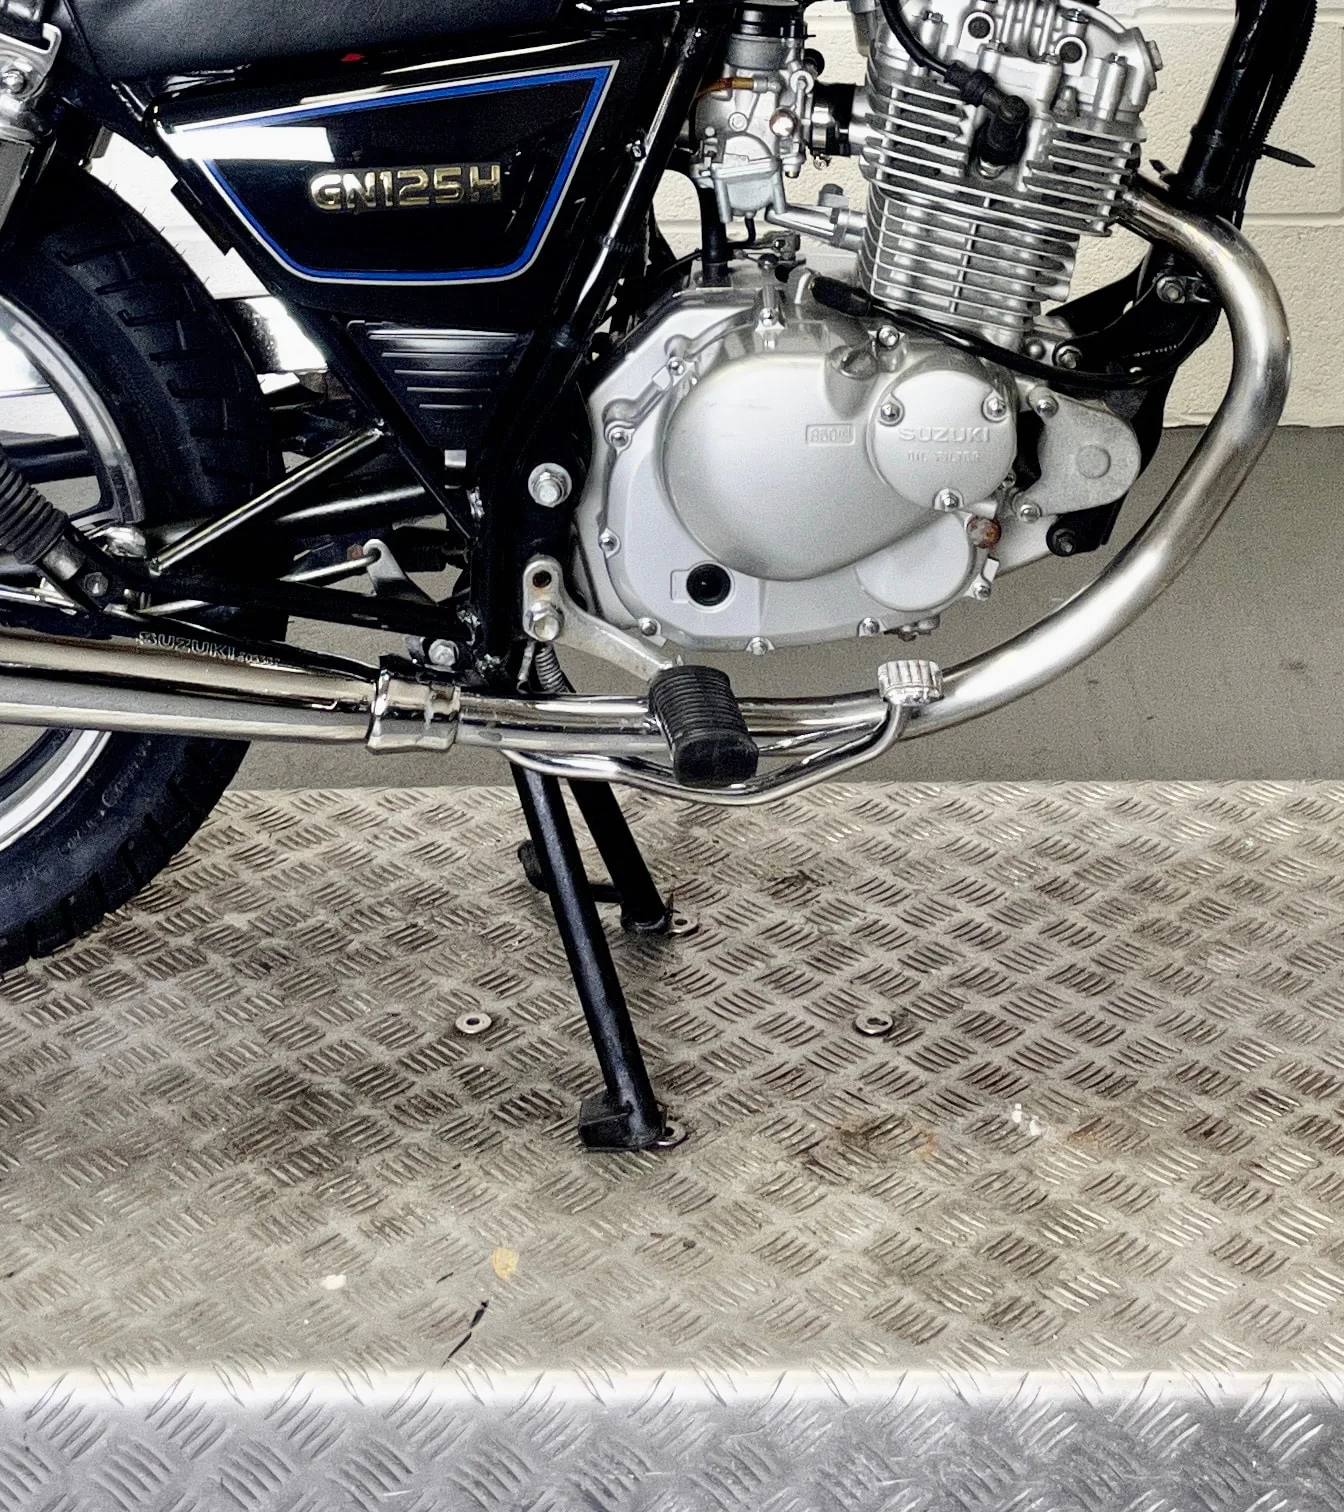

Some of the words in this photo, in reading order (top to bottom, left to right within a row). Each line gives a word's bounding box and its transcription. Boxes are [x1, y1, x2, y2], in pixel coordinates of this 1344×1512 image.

[309, 164, 502, 211] GN125H
[898, 426, 991, 443] SUZUKI
[135, 630, 237, 662] SUZUKI
